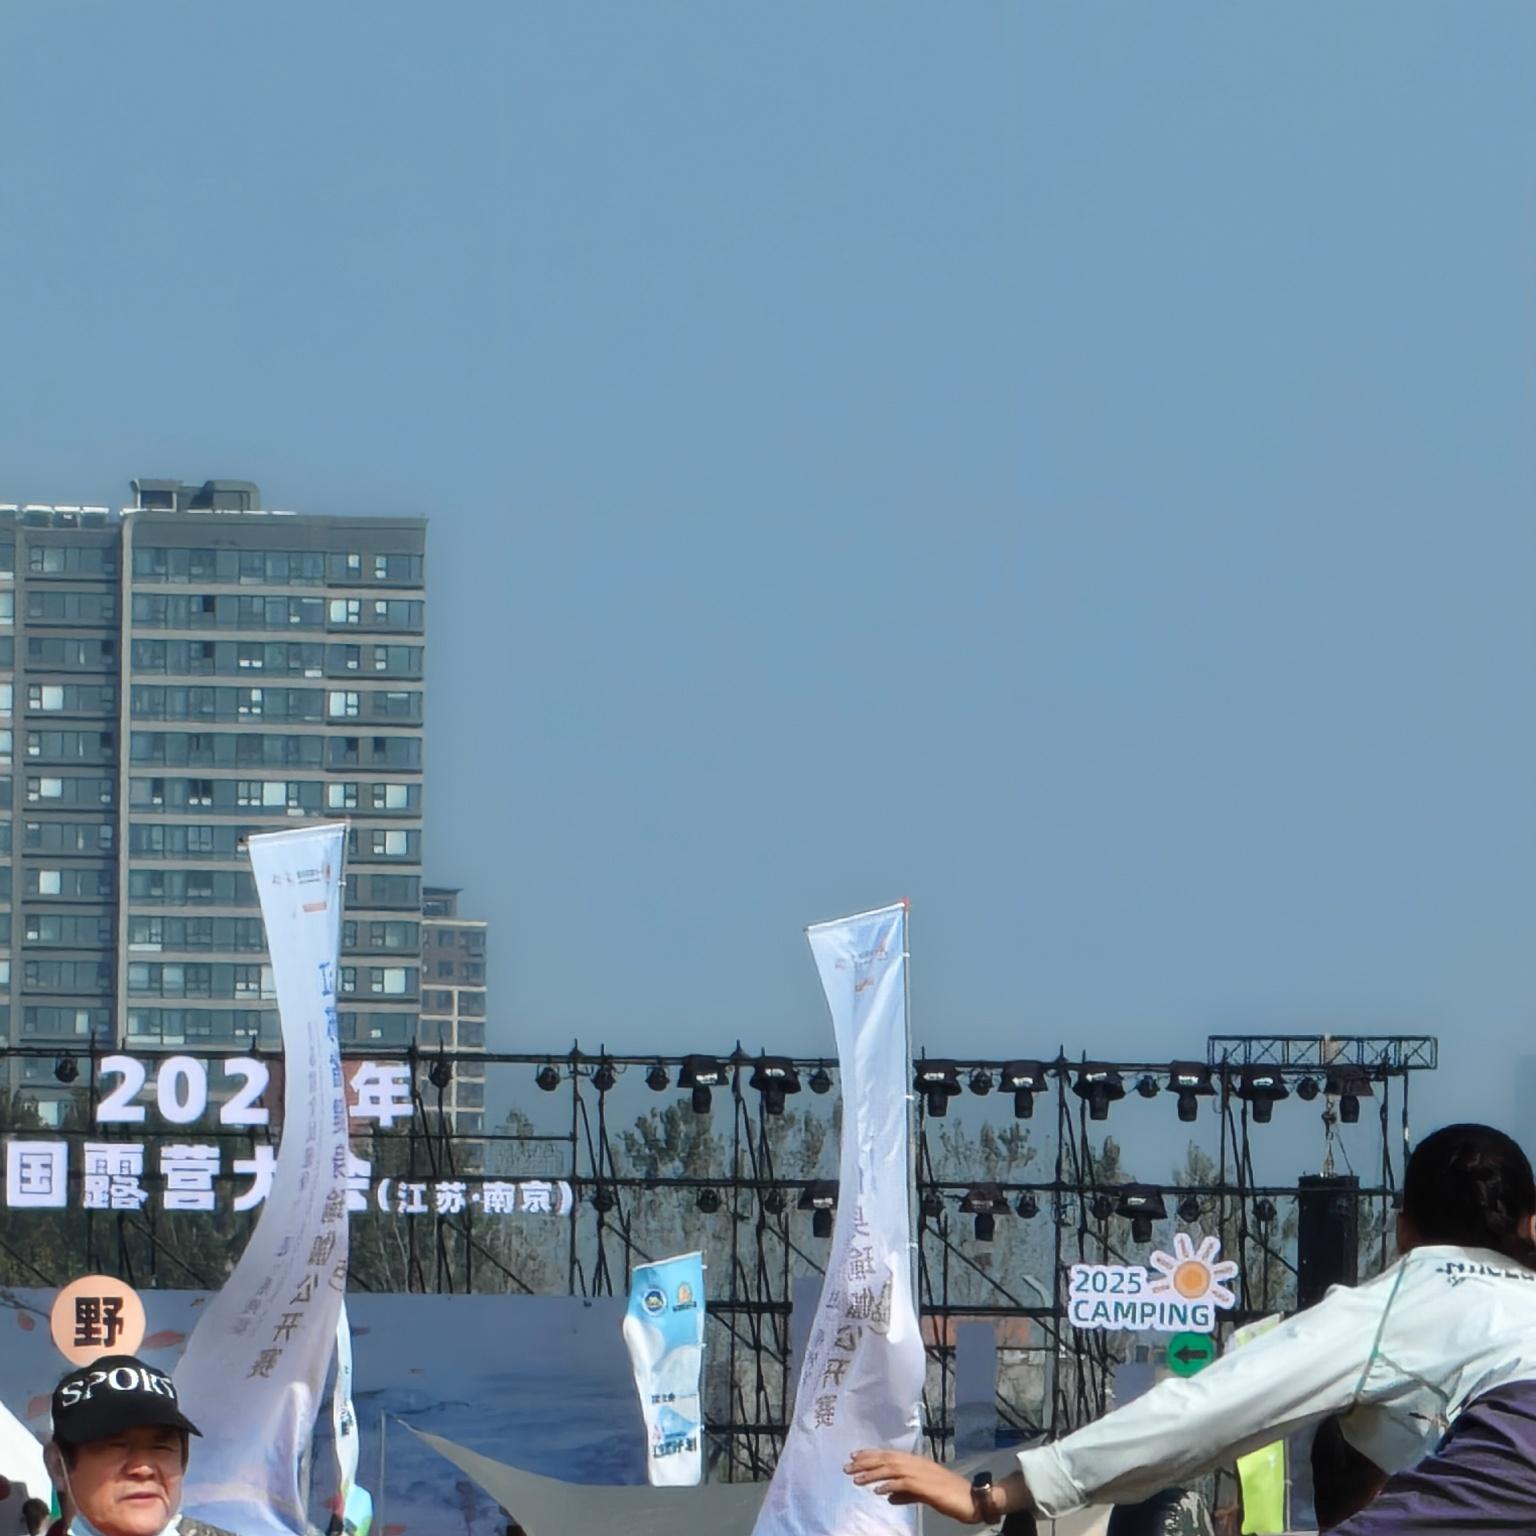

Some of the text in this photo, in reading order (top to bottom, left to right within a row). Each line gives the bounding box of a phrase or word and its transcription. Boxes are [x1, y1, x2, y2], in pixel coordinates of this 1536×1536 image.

[97, 1055, 414, 1127] 202年
[1074, 1270, 1142, 1295] 2025
[73, 1296, 125, 1348] 野
[1073, 1300, 1210, 1327] CAMPING
